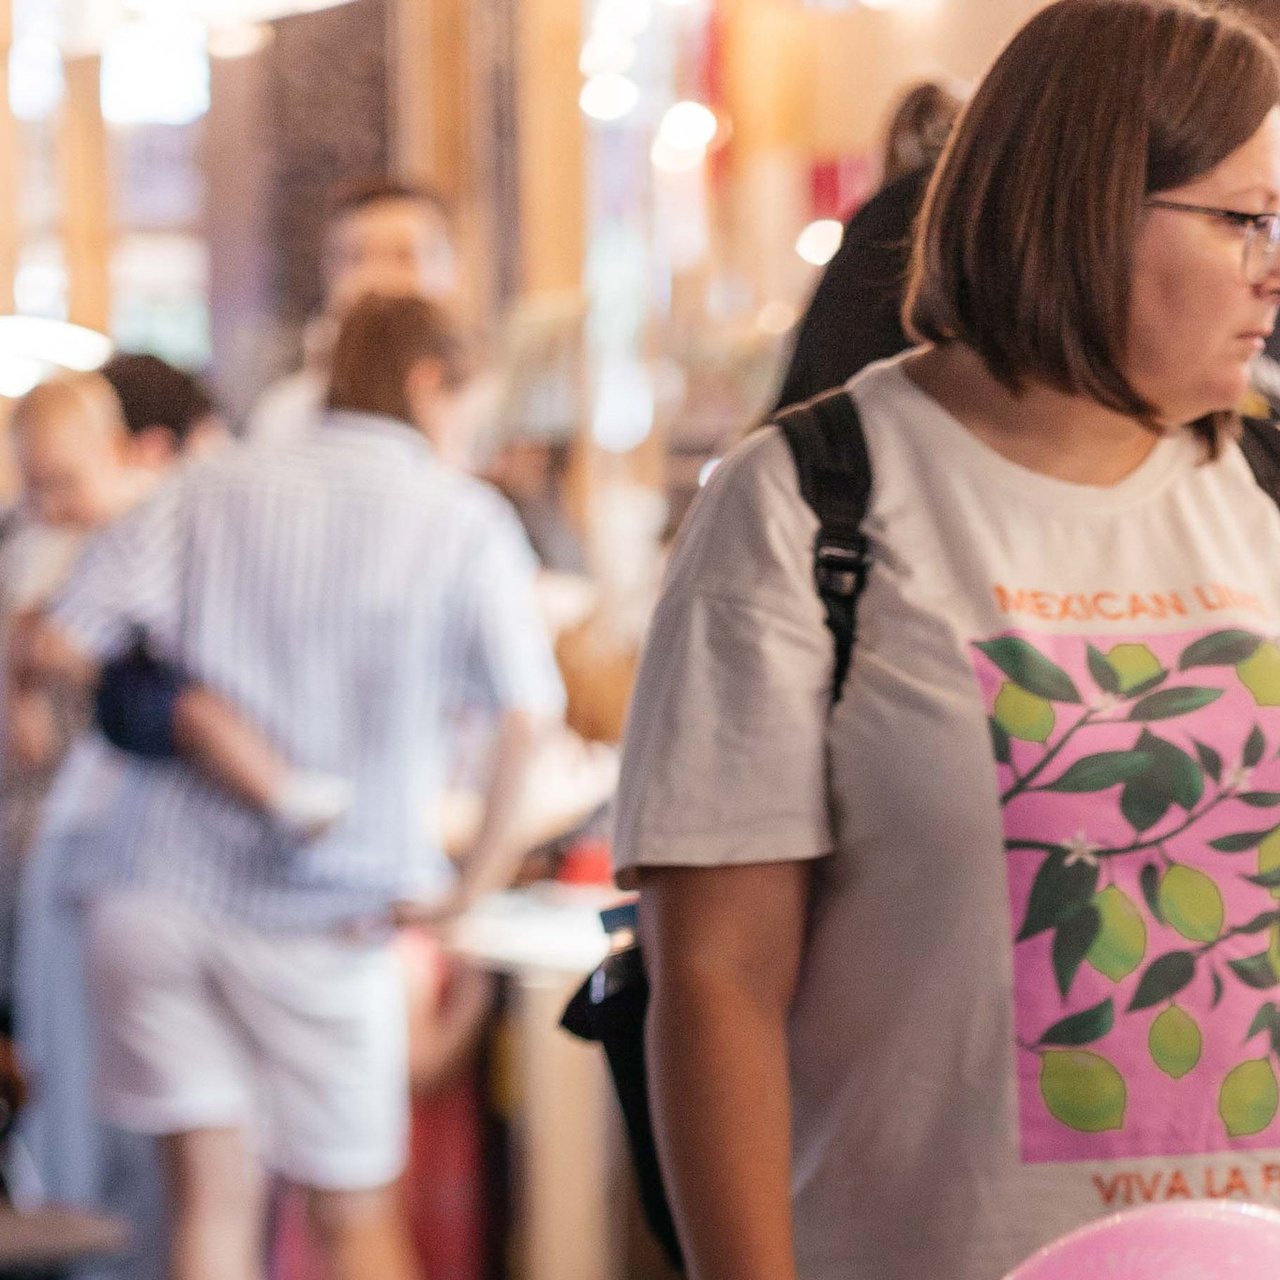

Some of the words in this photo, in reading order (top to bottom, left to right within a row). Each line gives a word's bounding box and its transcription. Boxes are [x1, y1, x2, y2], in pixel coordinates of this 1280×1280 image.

[993, 582, 1189, 621] MEXICAN
[1091, 1169, 1194, 1205] VIVA
[1204, 1165, 1251, 1199] LA
